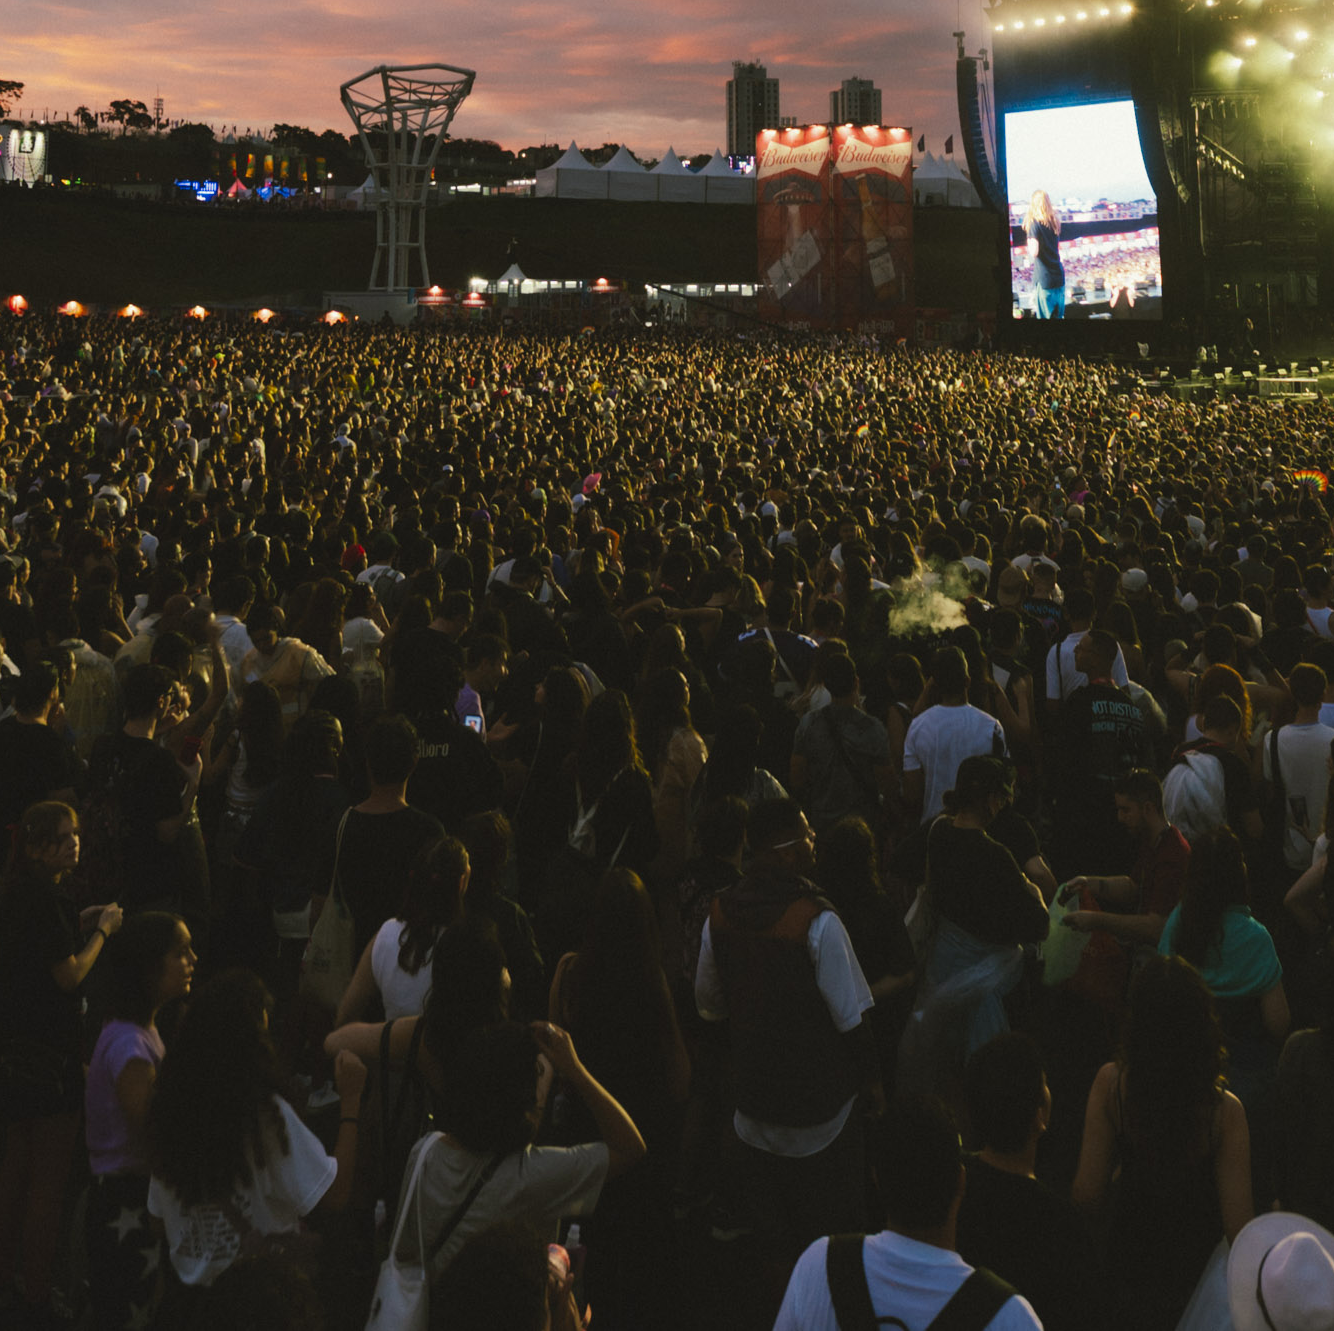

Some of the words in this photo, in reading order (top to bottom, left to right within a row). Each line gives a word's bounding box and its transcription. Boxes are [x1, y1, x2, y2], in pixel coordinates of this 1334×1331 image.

[761, 148, 830, 168] Budweiser
[838, 144, 910, 164] Budweiser
[417, 737, 450, 758] lboro
